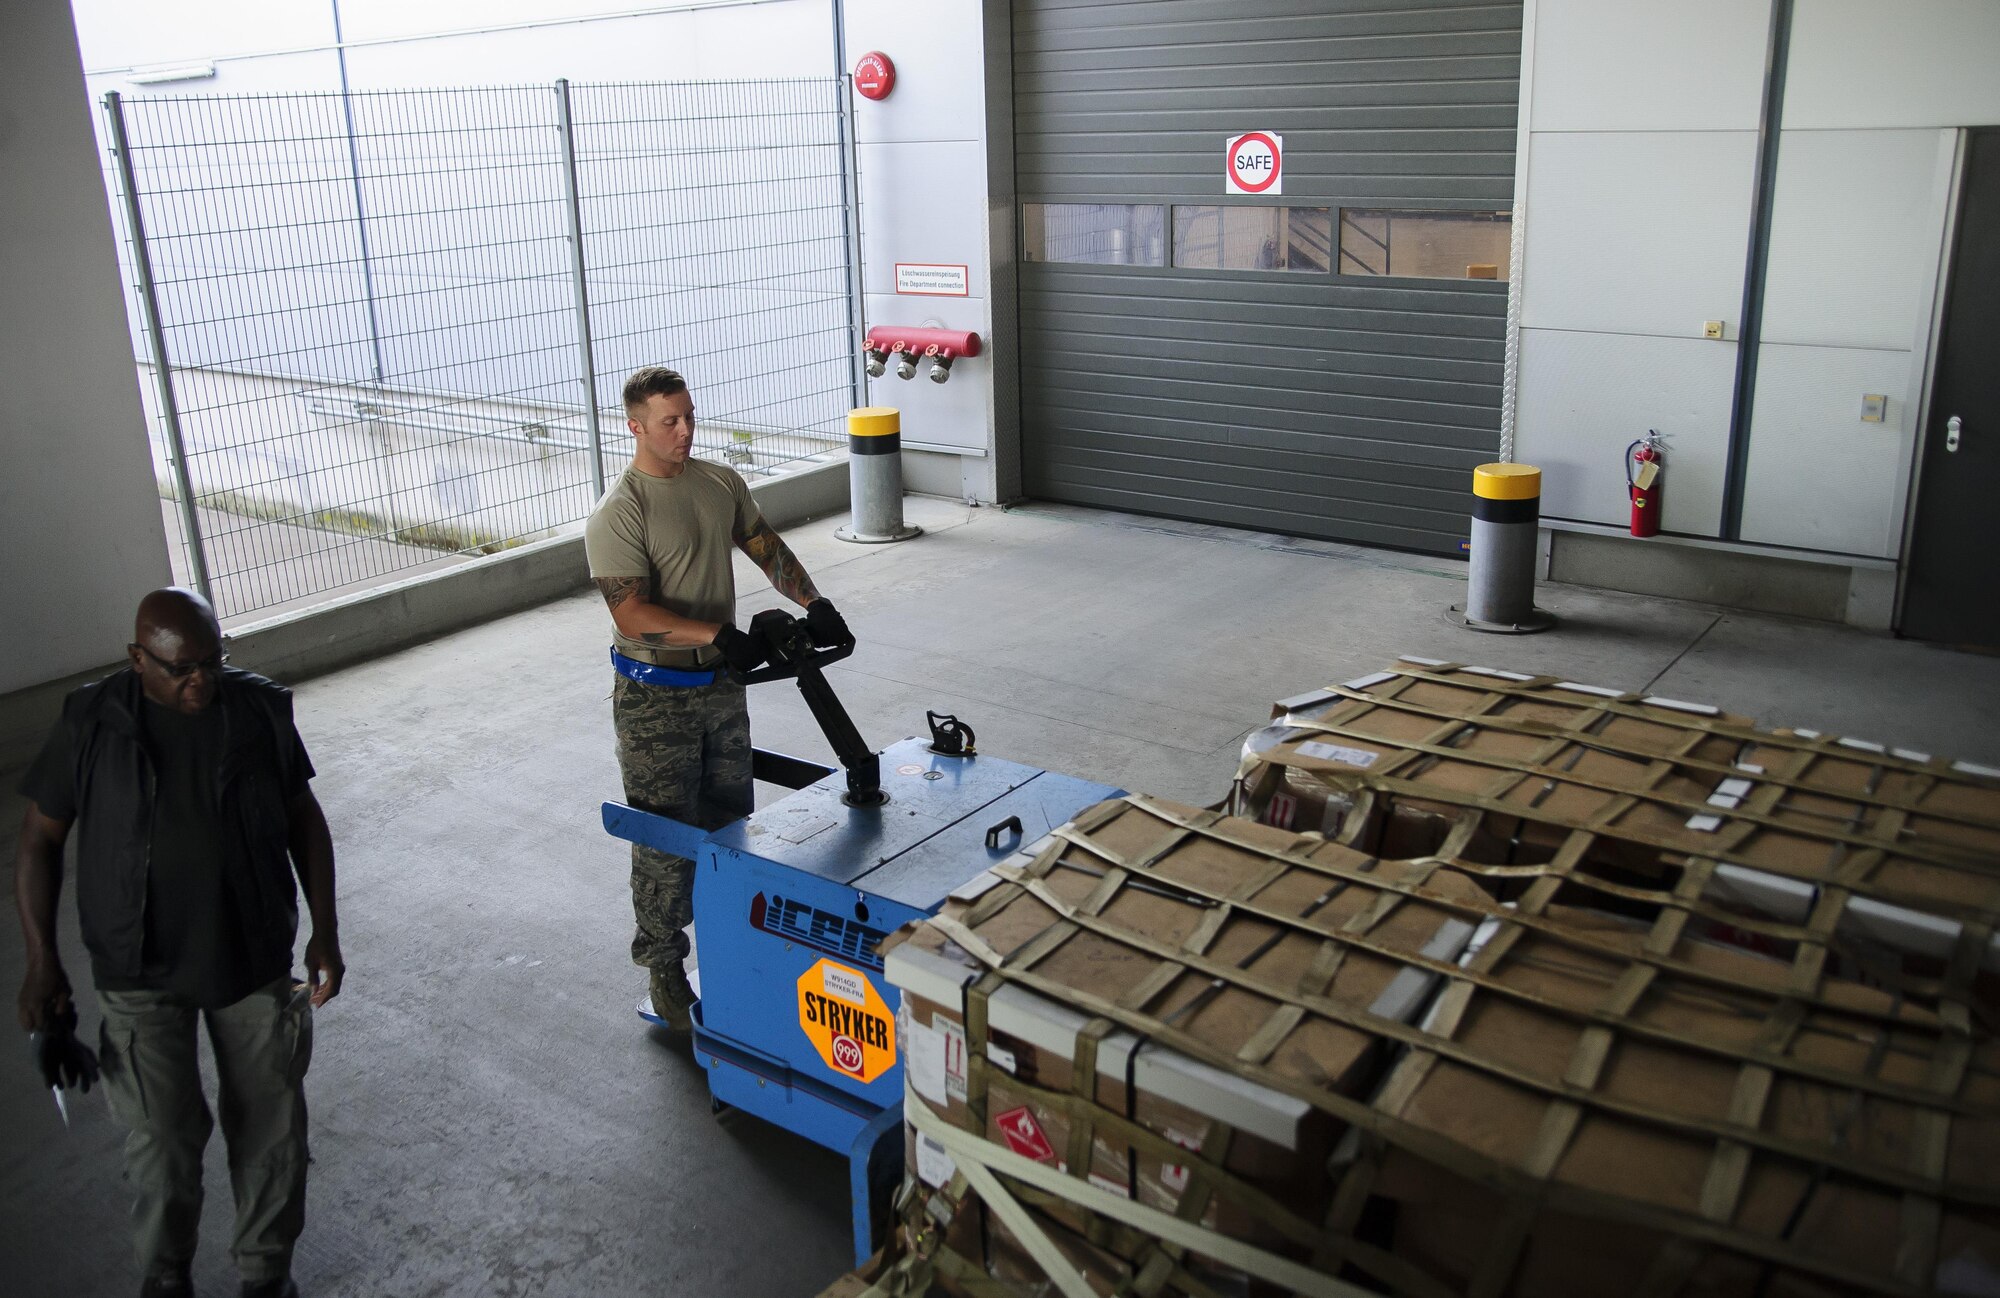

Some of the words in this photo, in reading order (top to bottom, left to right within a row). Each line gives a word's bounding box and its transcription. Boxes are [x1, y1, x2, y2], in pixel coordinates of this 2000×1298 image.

[1237, 155, 1272, 170] SAFE
[902, 270, 961, 279] Löschwassereinspeisung
[899, 279, 909, 287] Fire
[910, 280, 937, 288] Department
[825, 979, 864, 999] STRYKER-FRA
[831, 973, 857, 989] W914GD
[804, 991, 888, 1051] STRYKER
[836, 1044, 858, 1066] 999
